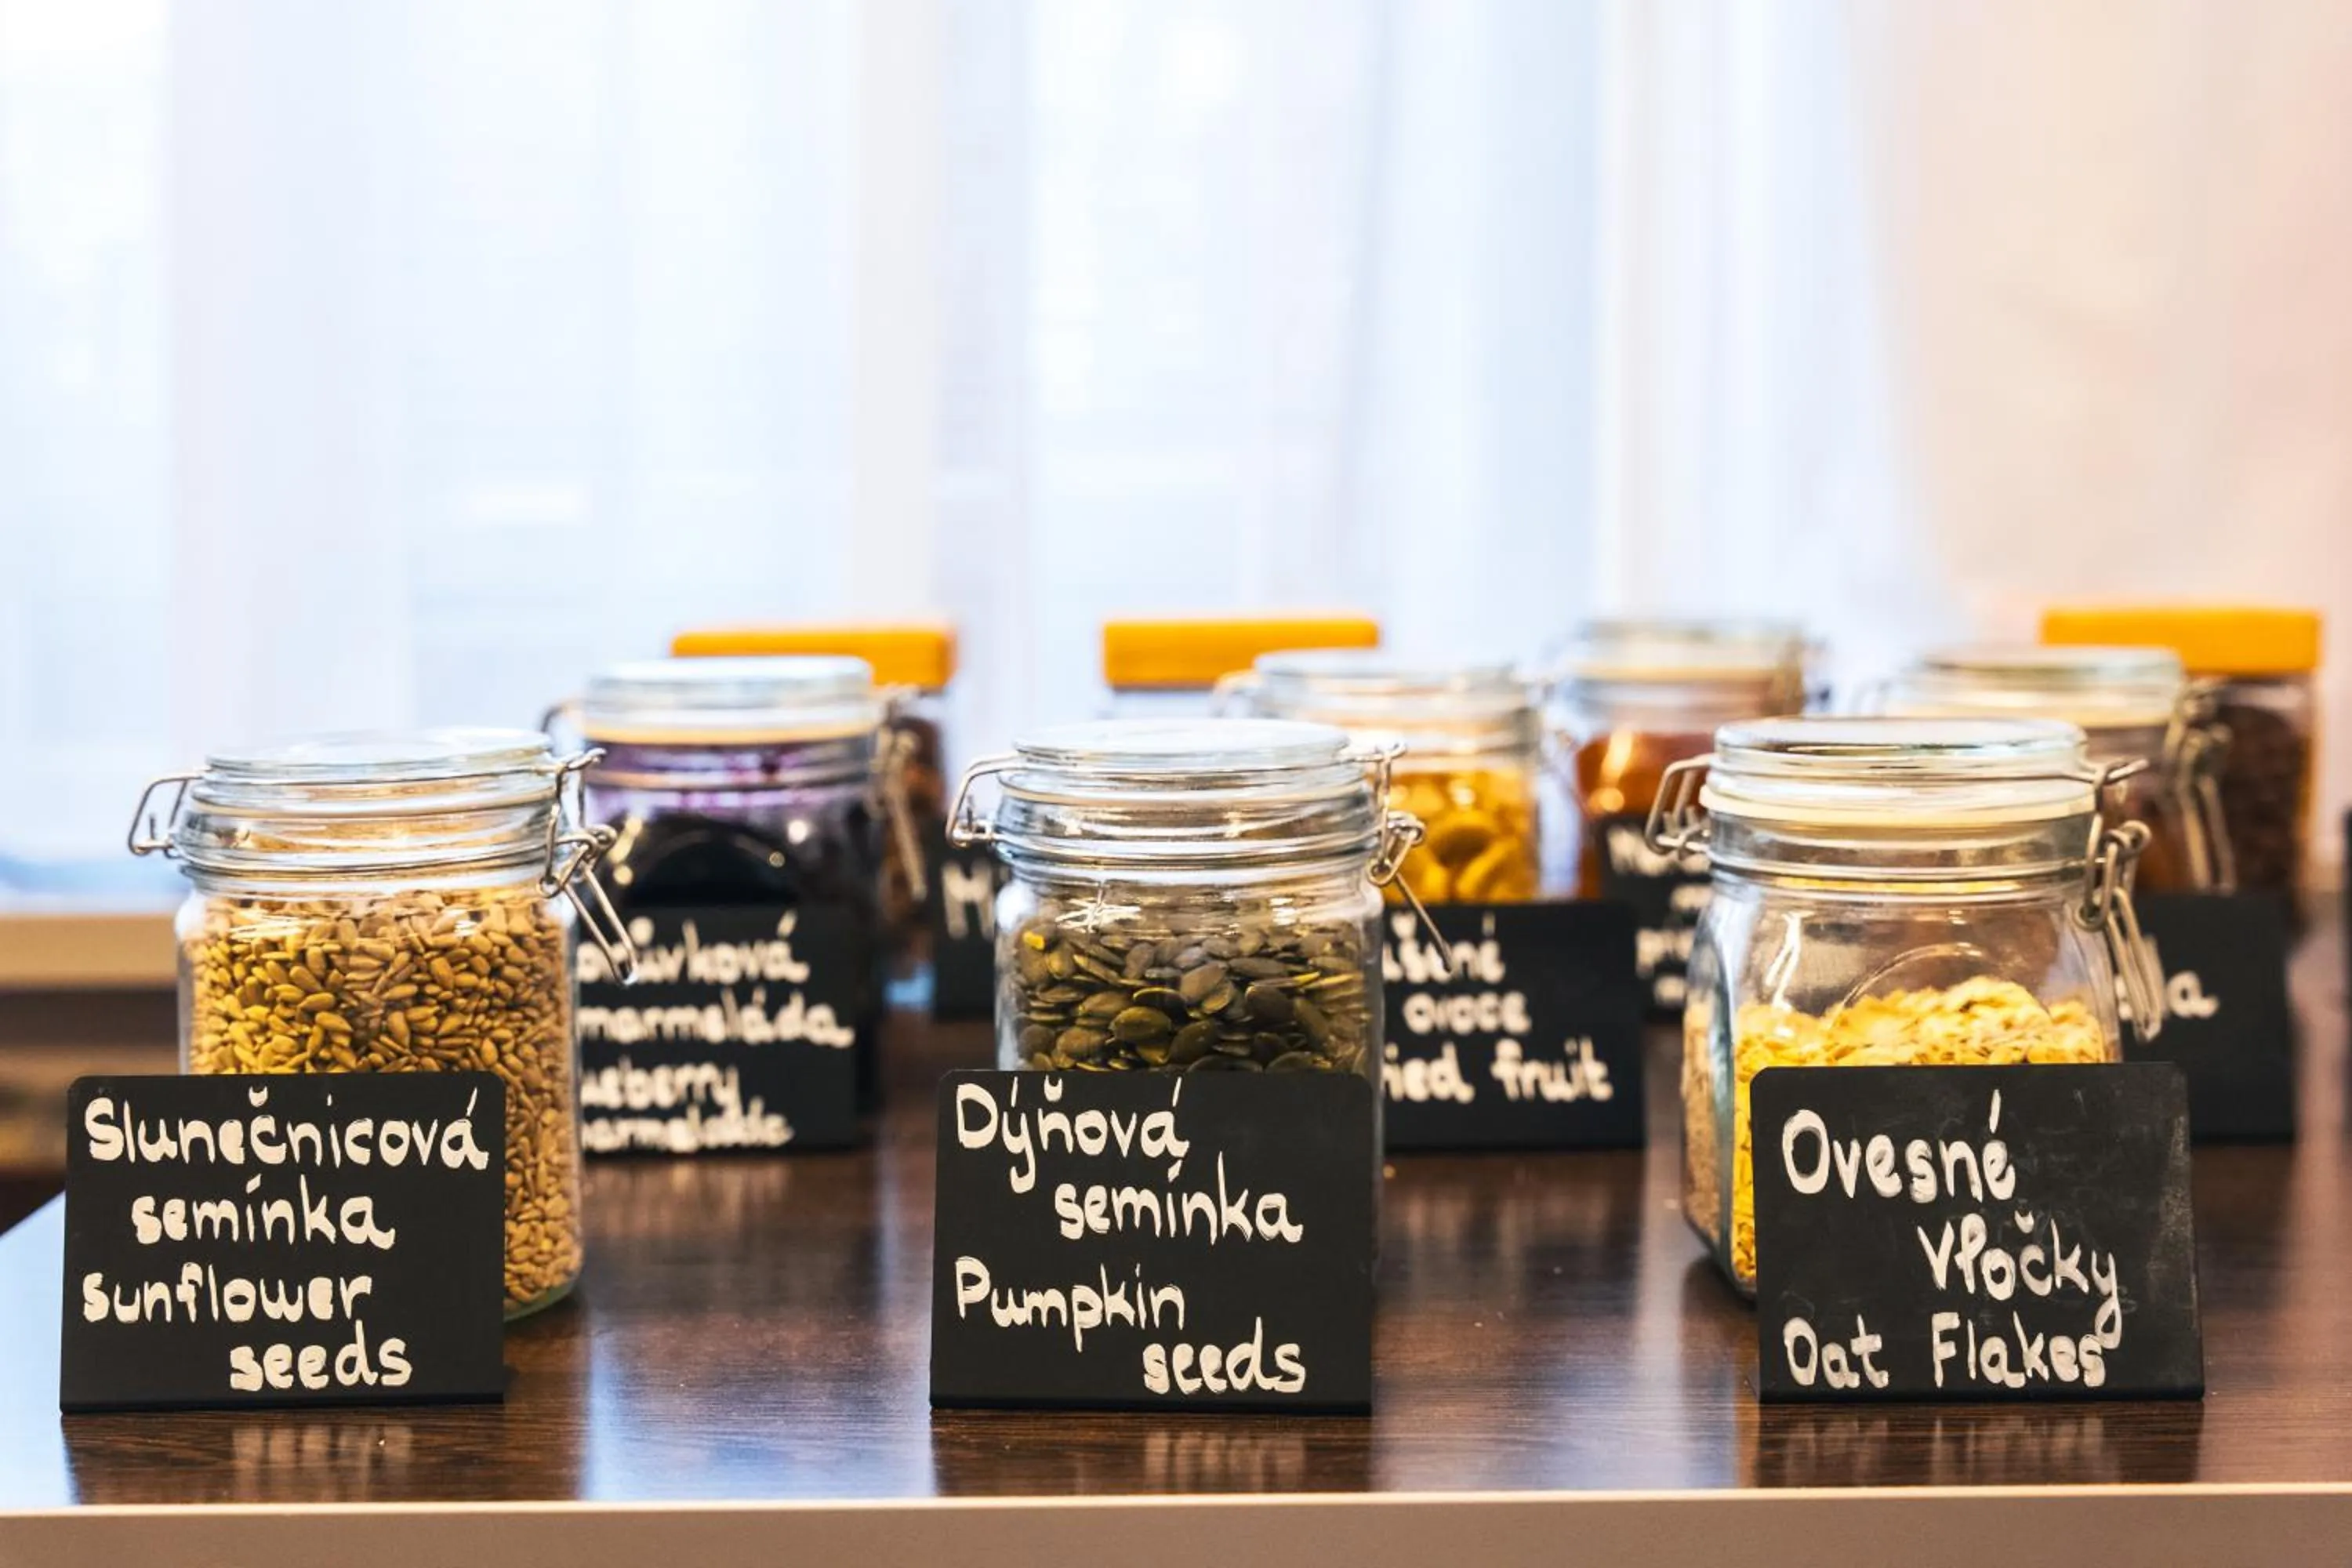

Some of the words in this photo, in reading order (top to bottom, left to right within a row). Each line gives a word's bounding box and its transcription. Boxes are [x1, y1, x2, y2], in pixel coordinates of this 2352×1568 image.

[1490, 1037, 1613, 1103] fruit
[85, 1087, 490, 1171] Slunečnicová
[956, 1076, 1190, 1194] Dýňová
[1781, 1089, 2016, 1203] Ovesné
[131, 1174, 396, 1250] semínka
[1054, 1150, 1304, 1245] semínka
[955, 1255, 1185, 1353] Pumpkin
[229, 1320, 413, 1392] seeds
[1142, 1316, 1306, 1396] seeds
[1782, 1314, 1889, 1389] Oat
[1931, 1311, 2107, 1389] Flakes
